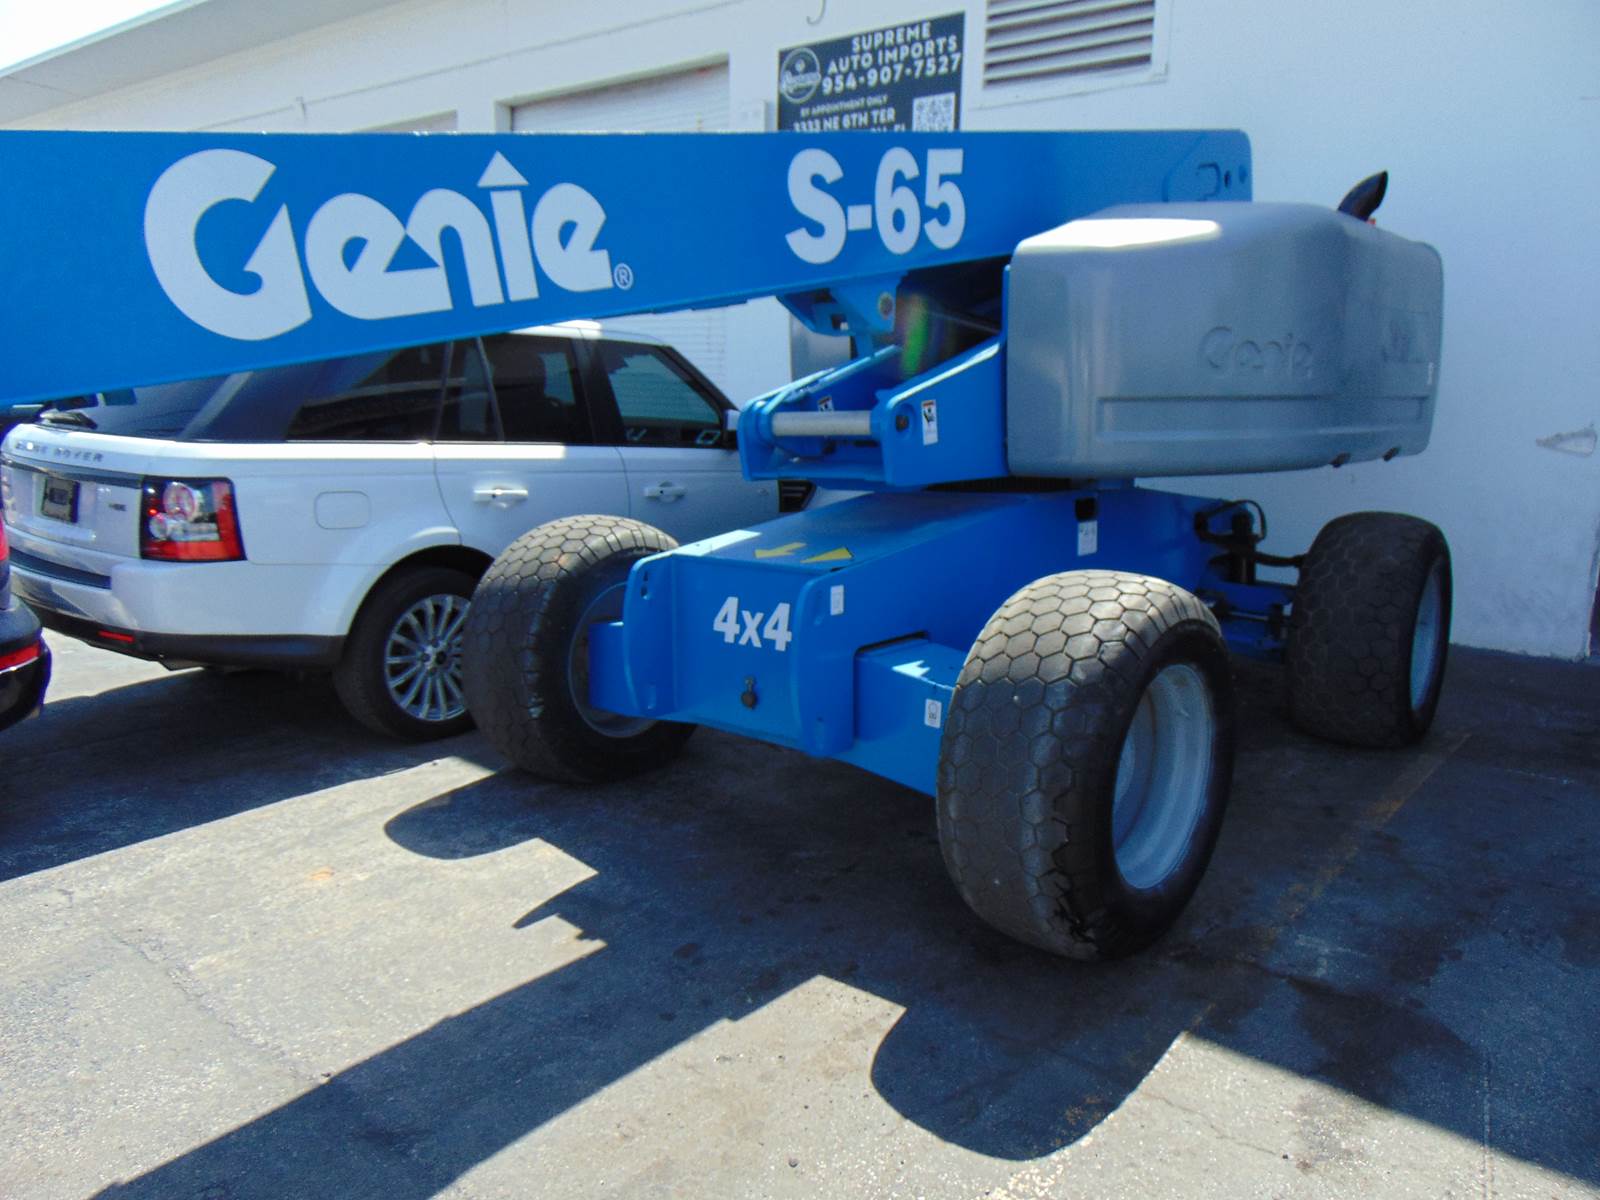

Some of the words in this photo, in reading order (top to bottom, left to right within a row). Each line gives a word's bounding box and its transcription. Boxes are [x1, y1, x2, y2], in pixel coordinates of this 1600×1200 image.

[827, 52, 873, 75] AUTO
[878, 35, 958, 65] IMPORTS
[852, 21, 931, 53] SUPREME
[823, 115, 840, 131] NE
[842, 111, 869, 129] 6TH
[871, 107, 896, 124] TER
[785, 147, 966, 265] S-65
[144, 148, 614, 341] Genie
[1200, 325, 1315, 381] Genie
[53, 446, 104, 462] ROVER
[713, 596, 793, 652] 4x4
